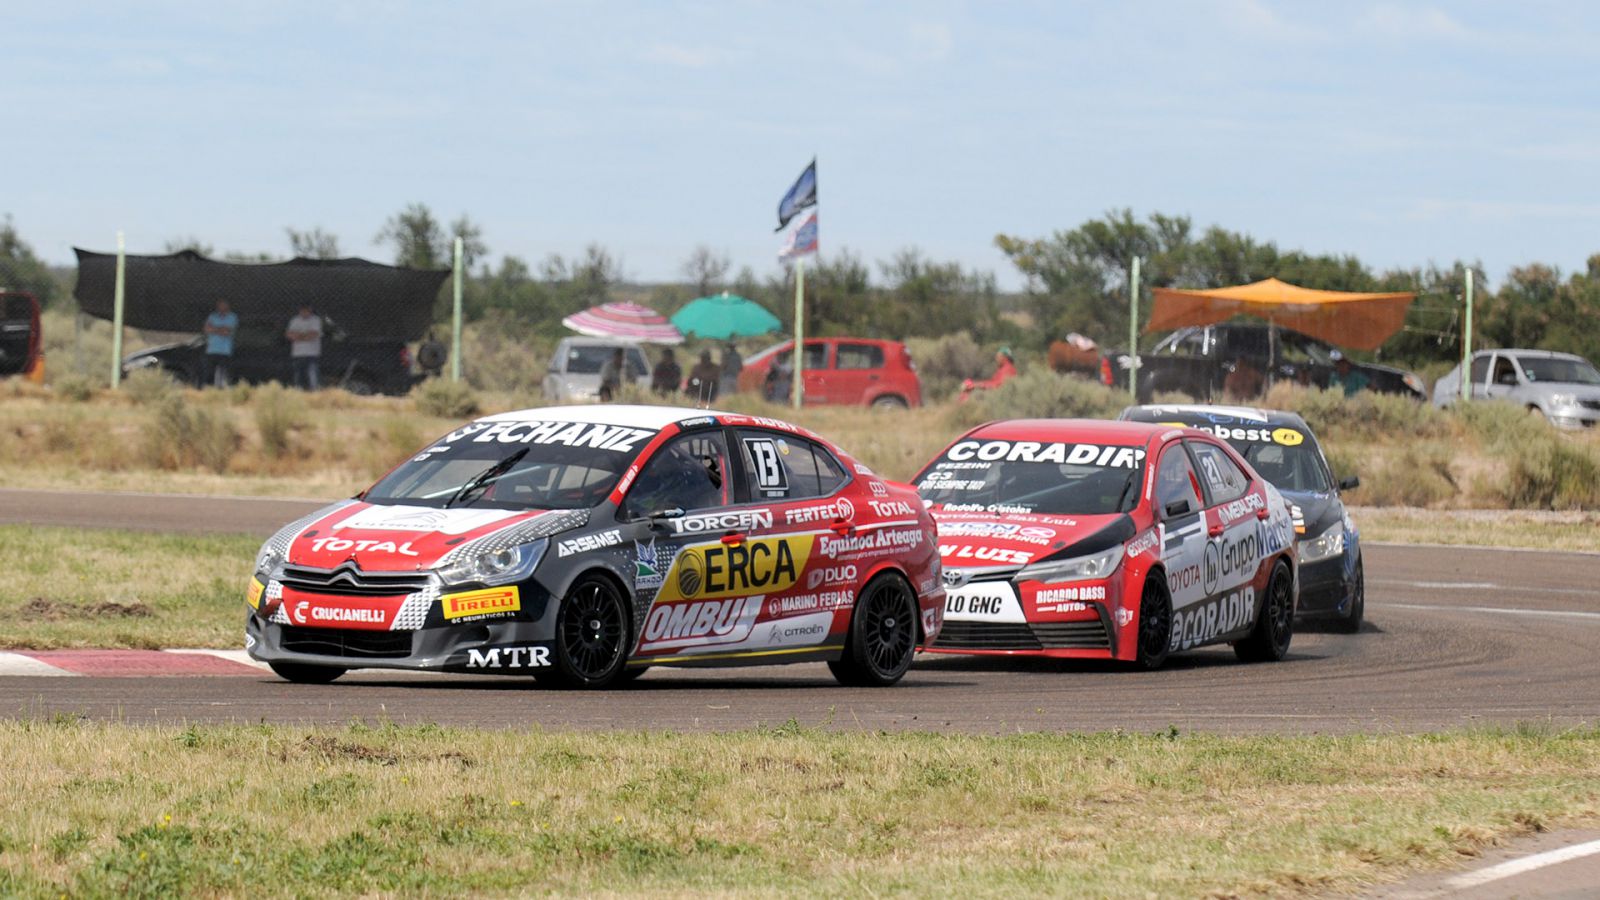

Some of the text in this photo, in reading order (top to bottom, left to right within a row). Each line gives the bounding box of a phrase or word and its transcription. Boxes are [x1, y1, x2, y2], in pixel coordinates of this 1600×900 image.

[473, 421, 655, 452] ECHANIZ
[753, 442, 779, 487] 13
[947, 441, 1145, 469] CORADIR
[936, 462, 992, 470] PEZZINI
[1202, 456, 1222, 483] 21
[785, 503, 839, 525] FERTEC
[868, 500, 916, 517] TOTAL
[943, 502, 985, 512] Rodolfo
[668, 508, 773, 533] TORCEN
[1041, 516, 1077, 526] Luis
[312, 537, 419, 556] TOTAL
[558, 529, 623, 558] ARSEMET
[875, 528, 923, 549] Arteaga
[956, 545, 1035, 563] LUIS
[1221, 534, 1254, 577] Grupo
[704, 539, 796, 593] ERCA
[825, 565, 857, 582] DUO
[451, 592, 513, 612] PIRELLI
[782, 594, 817, 611] MARINO
[820, 590, 854, 607] FERIAS
[969, 596, 1002, 614] GNC
[1036, 586, 1105, 604] RICARDO BASSI
[312, 606, 385, 622] CRUCIANELLI
[1056, 602, 1086, 613] AUTOS
[645, 599, 745, 641] OMBU
[466, 646, 551, 668] MTR
